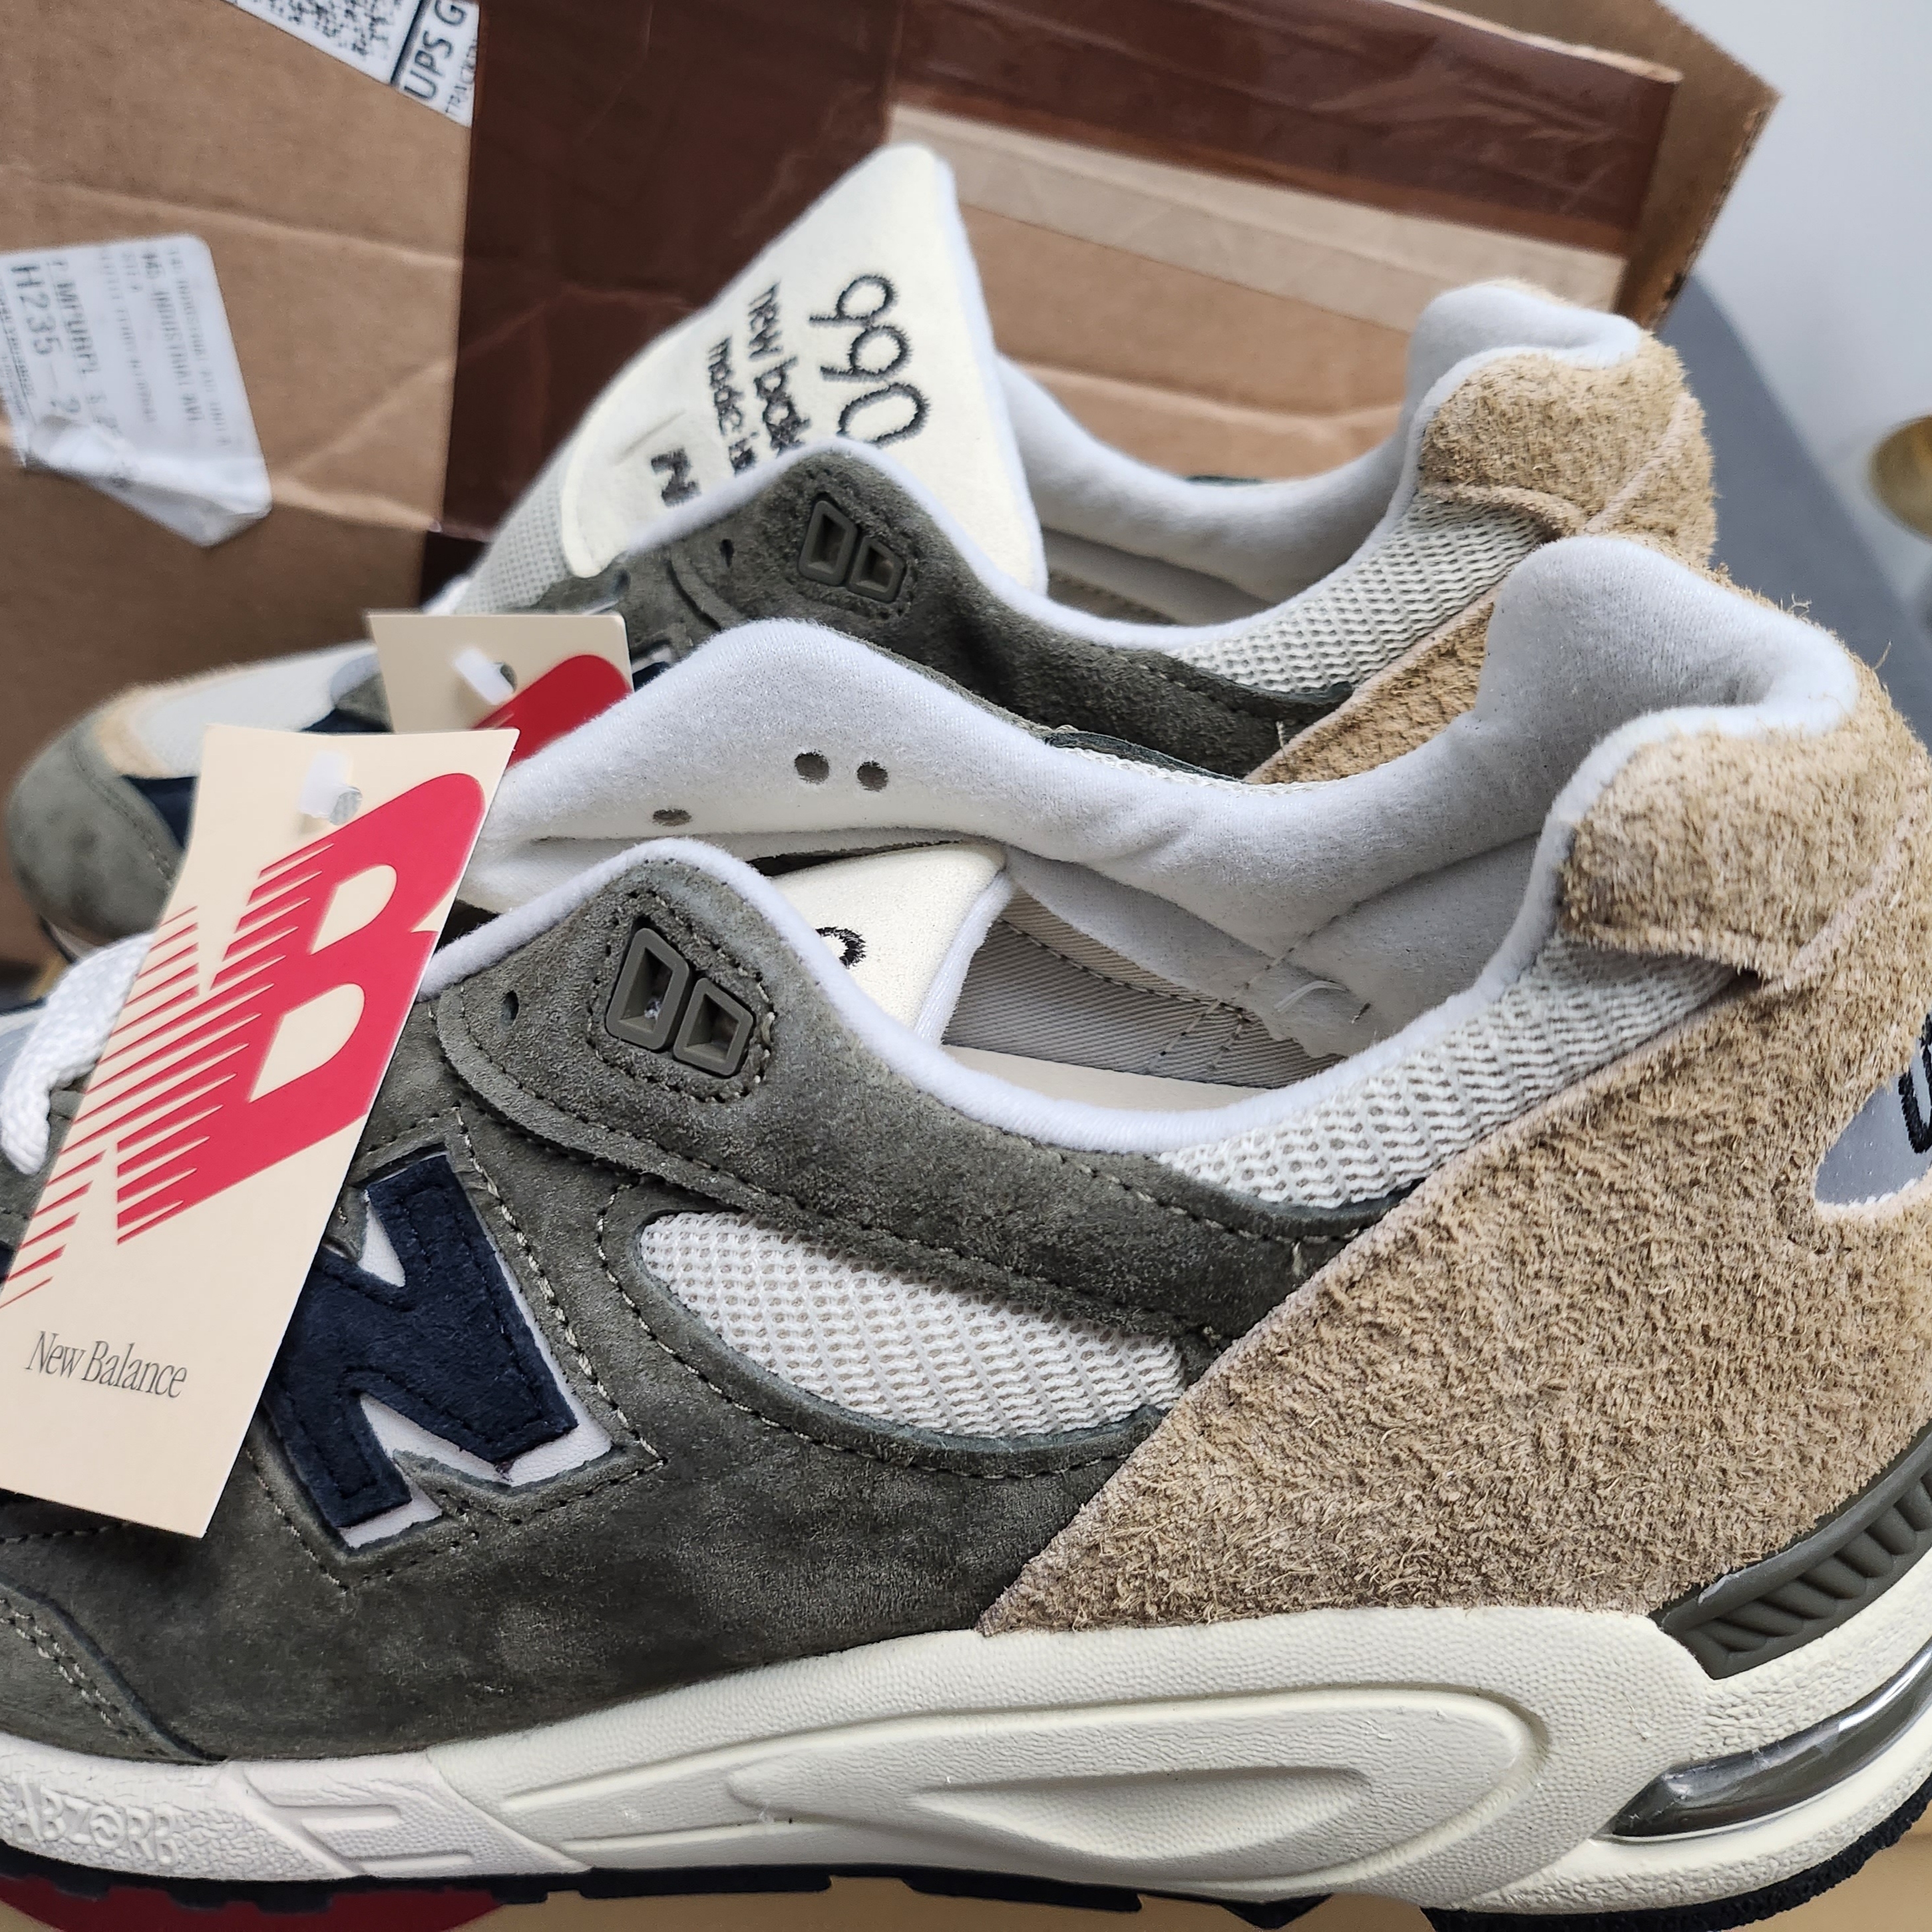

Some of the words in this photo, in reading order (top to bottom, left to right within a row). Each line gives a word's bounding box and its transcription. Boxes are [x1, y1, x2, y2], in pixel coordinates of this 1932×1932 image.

[403, 30, 455, 100] UPS
[10, 262, 64, 356] H235
[808, 274, 930, 448] 990
[24, 1330, 87, 1379] New
[81, 1340, 189, 1399] Balance
